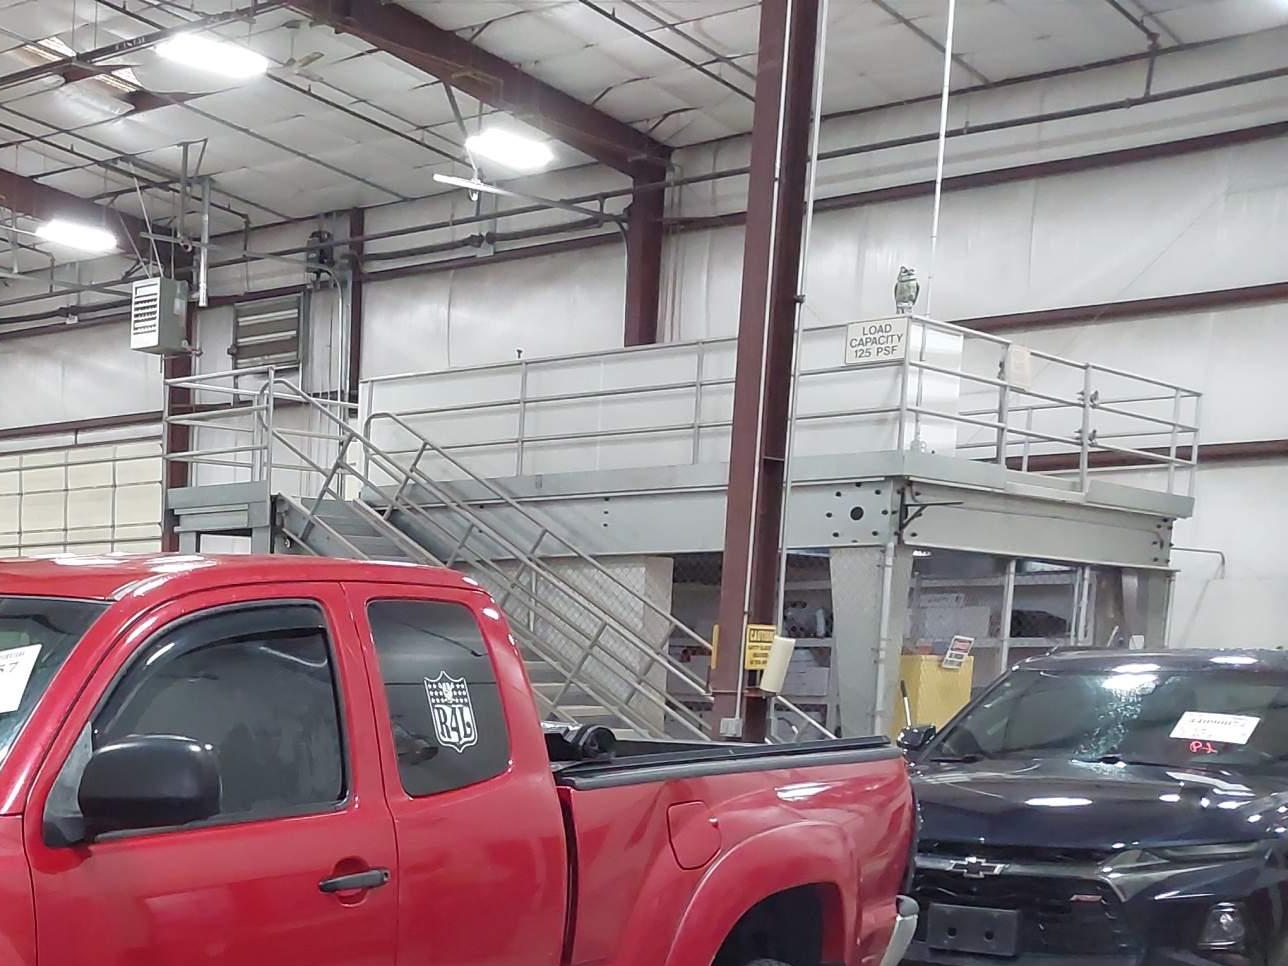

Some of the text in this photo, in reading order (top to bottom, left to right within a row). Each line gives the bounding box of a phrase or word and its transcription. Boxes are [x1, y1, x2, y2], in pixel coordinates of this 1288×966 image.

[862, 324, 892, 336] LOAD
[849, 334, 903, 348] CAPACITY
[855, 345, 898, 358] 125 PSF
